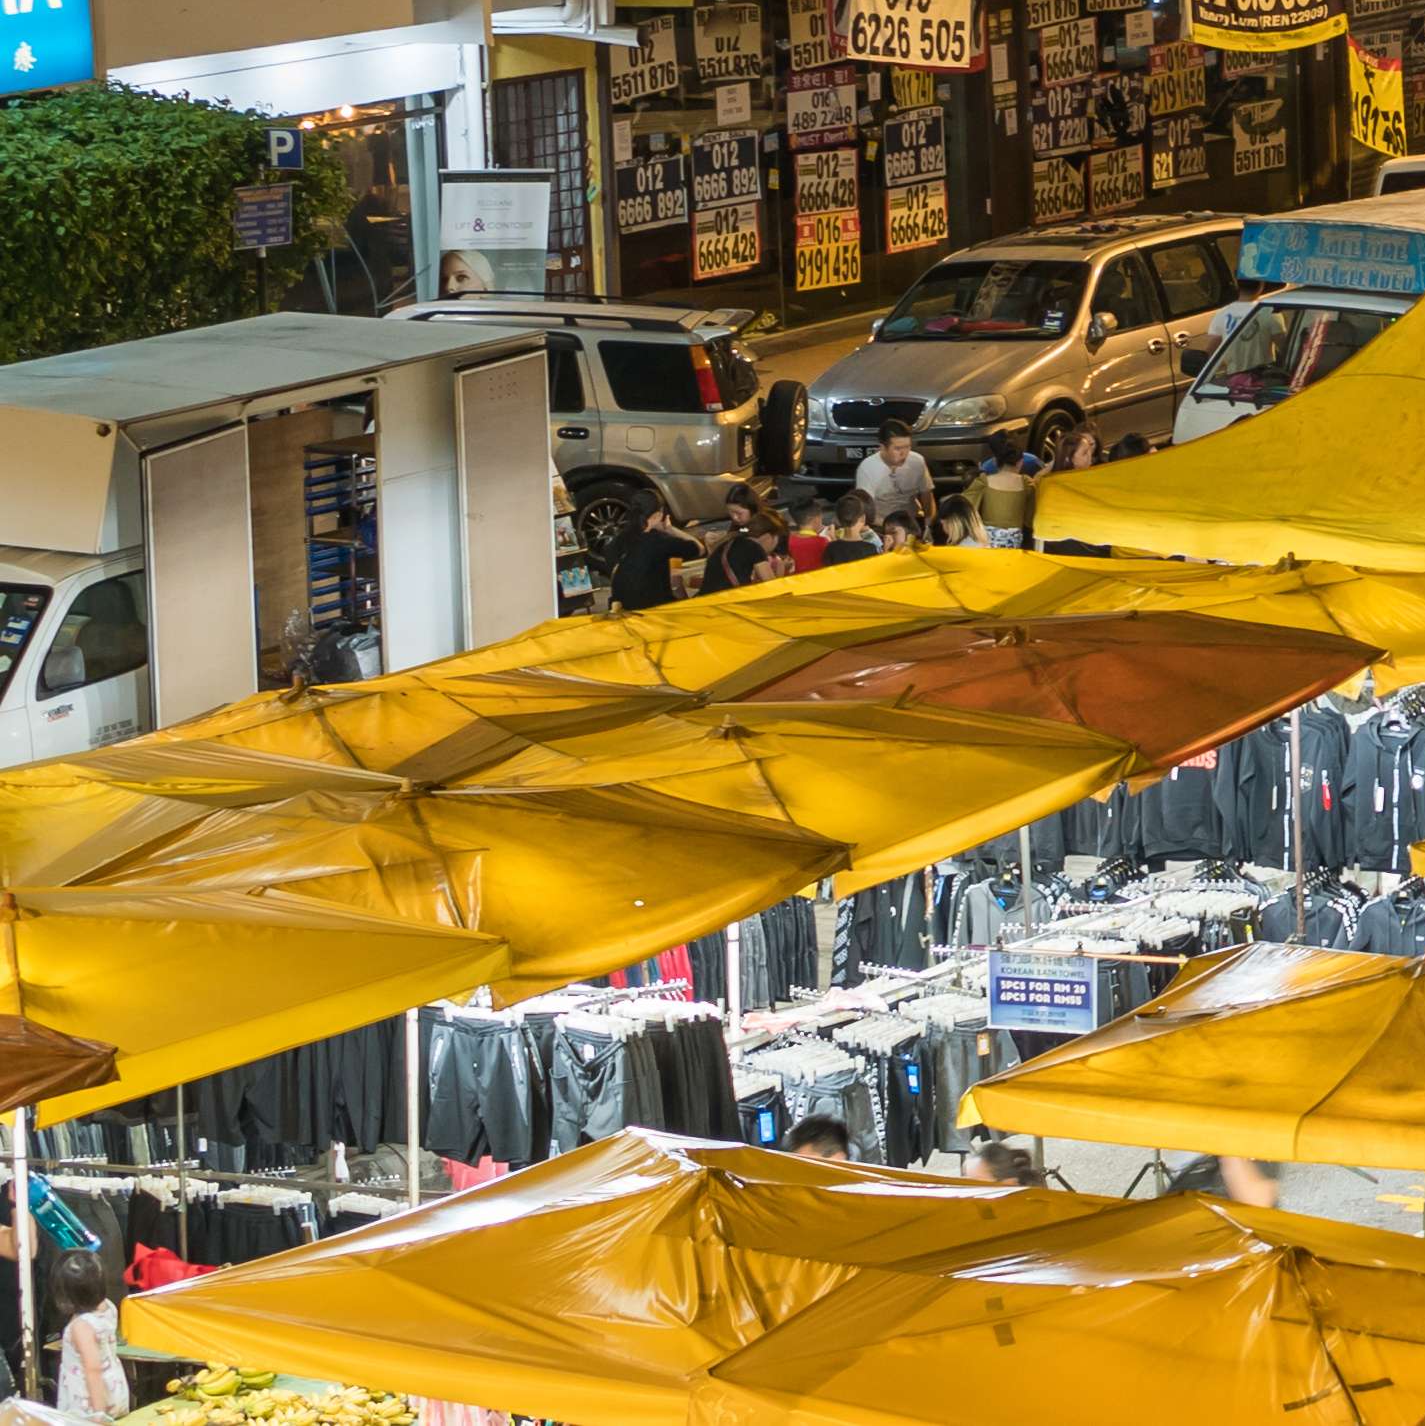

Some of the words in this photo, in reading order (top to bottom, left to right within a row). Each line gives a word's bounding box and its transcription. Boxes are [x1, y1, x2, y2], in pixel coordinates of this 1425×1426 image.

[851, 12, 911, 59] 6226
[920, 19, 966, 62] 505
[1058, 23, 1081, 49] 012
[1166, 43, 1188, 73] 016
[612, 70, 645, 100] 5511
[650, 61, 676, 91] 876
[1048, 87, 1072, 118] 012
[792, 112, 817, 132] 489
[902, 122, 927, 147] 012
[1032, 121, 1054, 151] 621
[1168, 118, 1191, 148] 012
[269, 131, 295, 167] P
[712, 141, 739, 169] 012
[886, 149, 915, 176] 6666
[921, 144, 943, 172] 892
[1107, 149, 1128, 176] 012
[1236, 149, 1262, 174] 5511
[1264, 144, 1285, 168] 876
[636, 164, 664, 192] 012
[815, 153, 840, 180] 012
[1152, 150, 1174, 181] 621
[694, 172, 728, 202] 6666
[732, 166, 757, 196] 892
[800, 179, 830, 213] 6666
[832, 178, 855, 208] 428
[906, 185, 928, 211] 012
[618, 195, 652, 226] 6666
[657, 189, 684, 219] 892
[714, 208, 740, 235] 012
[473, 218, 485, 232] &
[816, 216, 841, 246] 016
[891, 214, 920, 245] 6666
[922, 207, 945, 237] 428
[699, 238, 730, 272] 6666
[732, 232, 757, 263] 428
[798, 246, 830, 288] 9191
[832, 242, 859, 283] 456
[1029, 981, 1050, 992] FOR
[1029, 993, 1050, 1003] FOR
